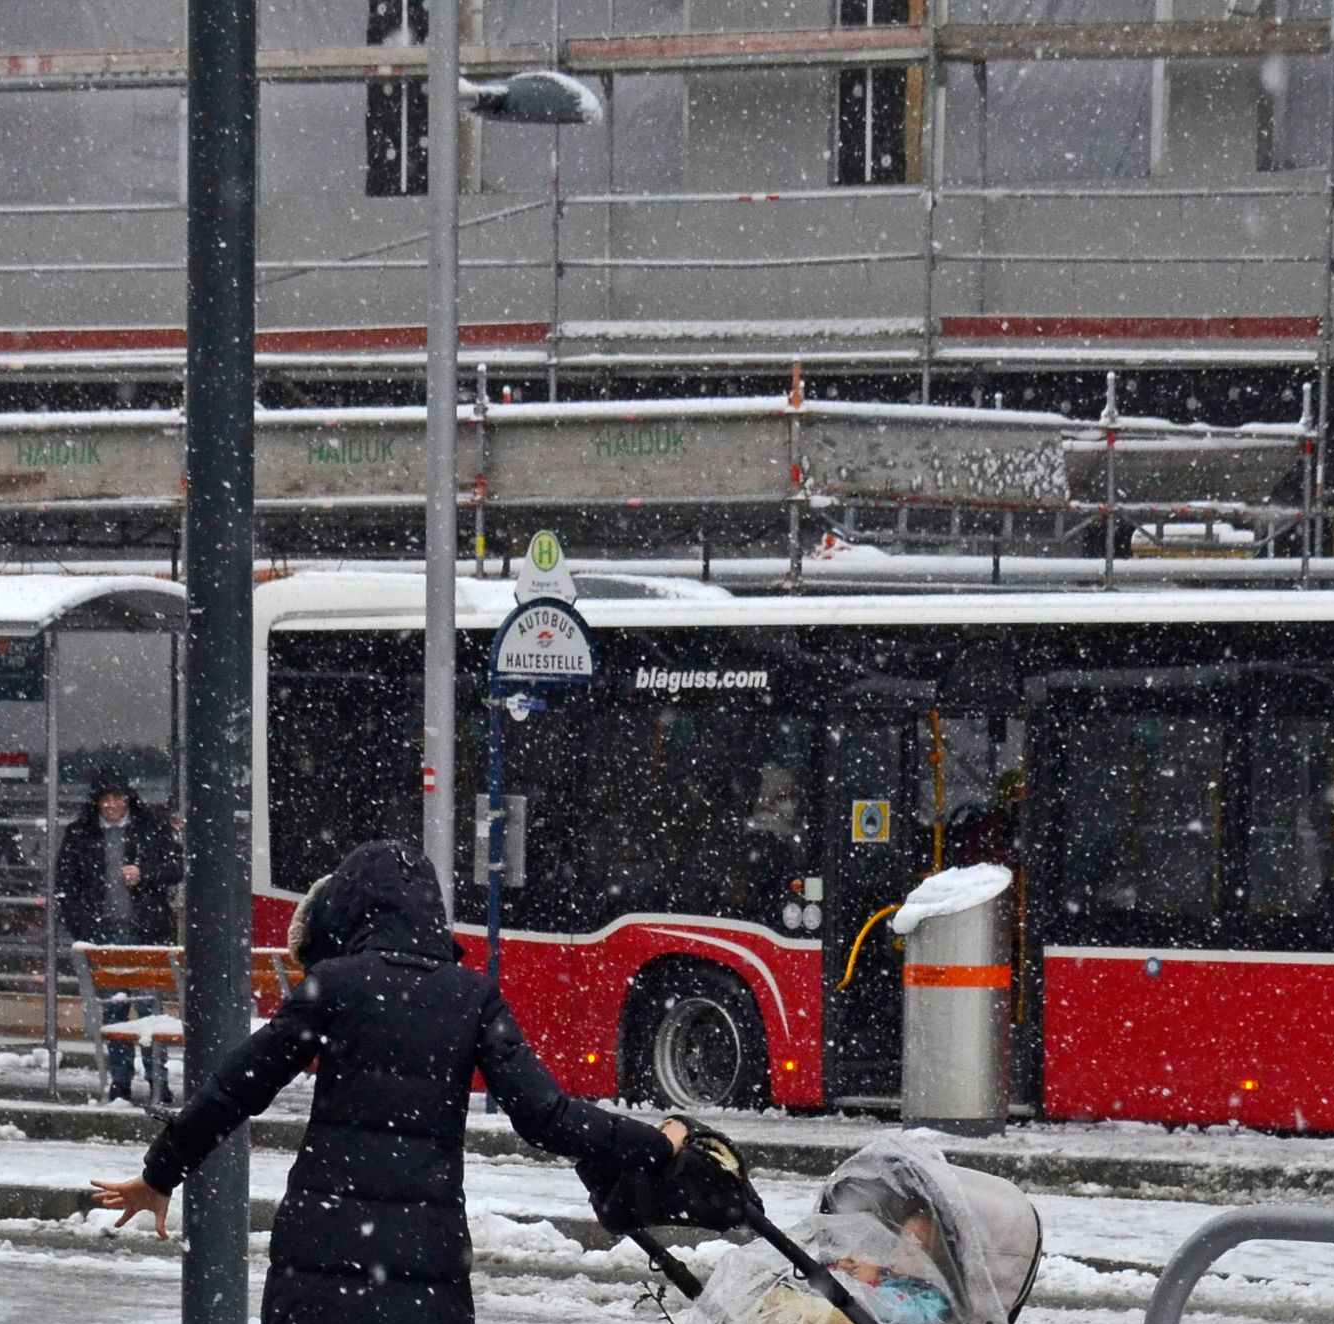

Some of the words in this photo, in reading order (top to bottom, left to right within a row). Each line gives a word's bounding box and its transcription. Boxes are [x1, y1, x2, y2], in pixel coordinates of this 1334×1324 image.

[17, 439, 101, 466] HAIDUK
[307, 437, 395, 465] HAIDUK
[595, 428, 688, 457] HAIDUK
[518, 610, 576, 640] AUTOBUS
[505, 652, 584, 671] HALTESTELLE
[635, 666, 768, 694] blaguss.com
